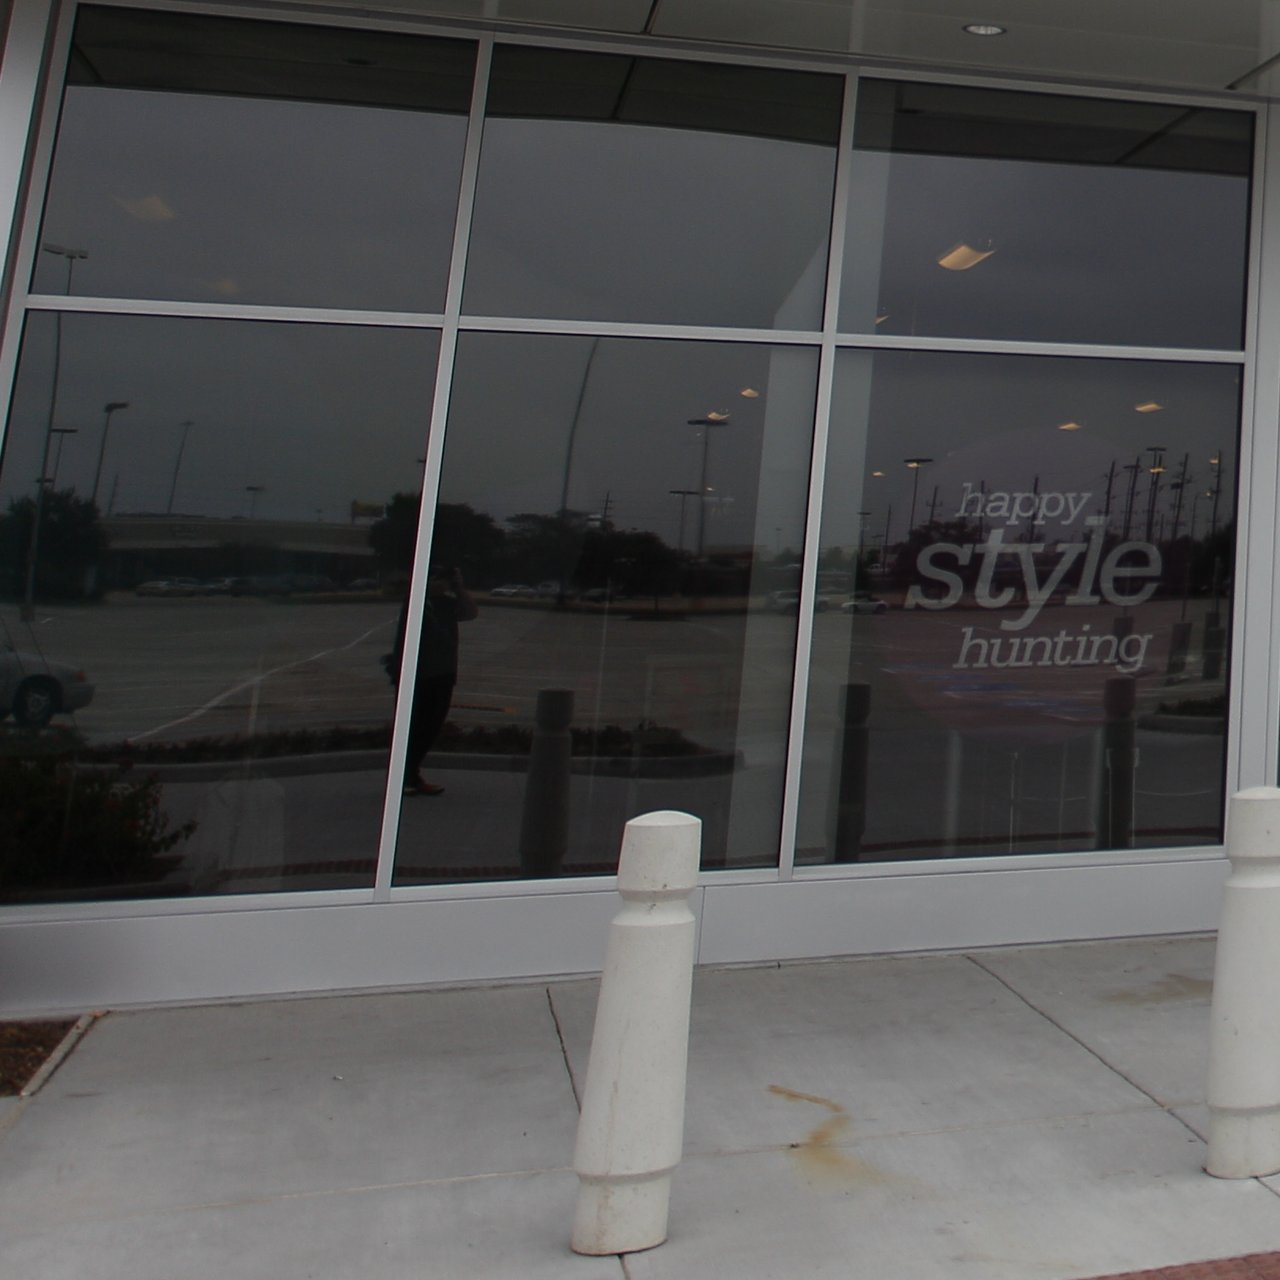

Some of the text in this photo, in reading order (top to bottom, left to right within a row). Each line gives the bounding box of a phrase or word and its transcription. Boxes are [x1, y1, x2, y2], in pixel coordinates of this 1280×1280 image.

[954, 483, 1092, 525] happy
[904, 516, 1162, 631] style
[953, 624, 1152, 672] hunting
